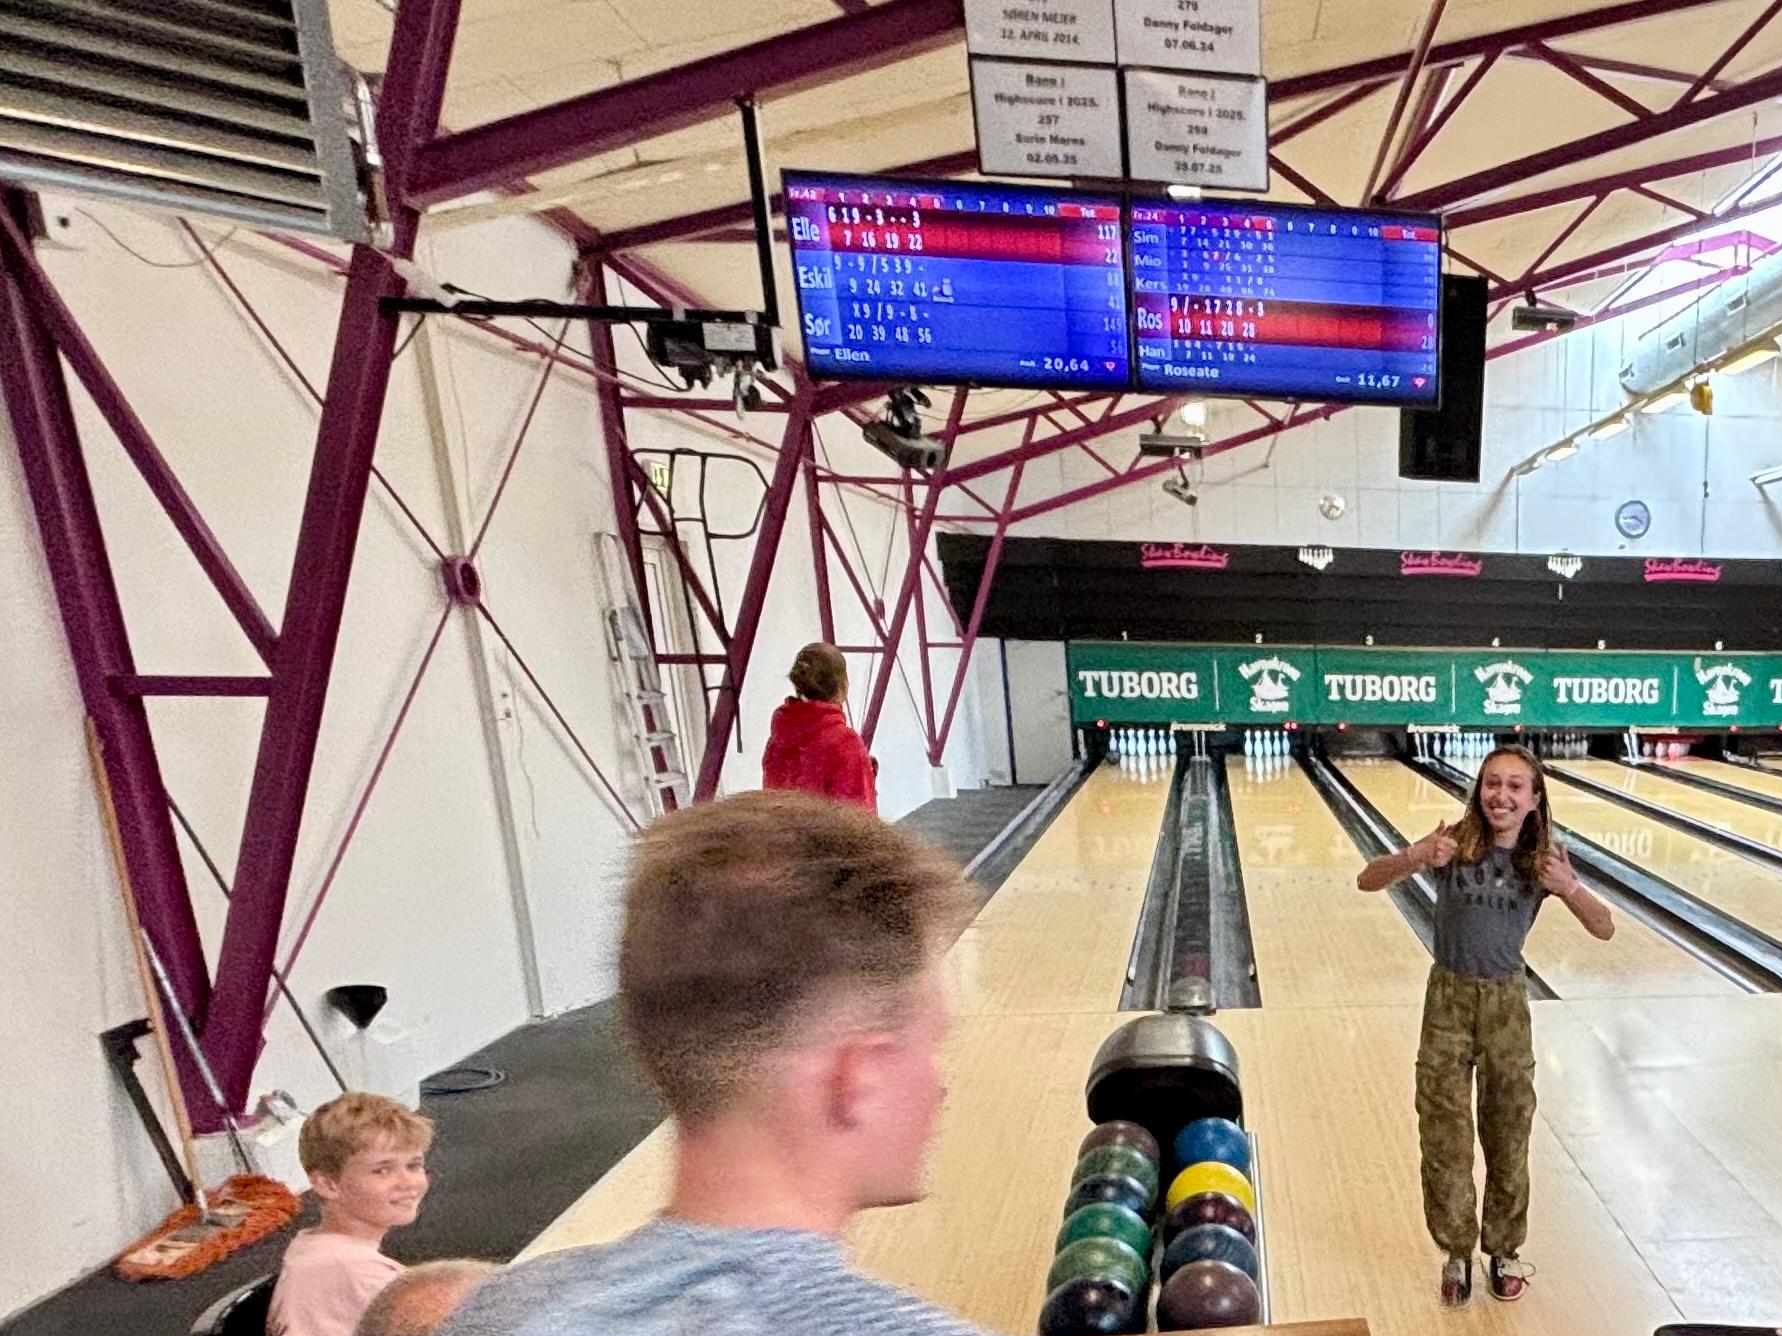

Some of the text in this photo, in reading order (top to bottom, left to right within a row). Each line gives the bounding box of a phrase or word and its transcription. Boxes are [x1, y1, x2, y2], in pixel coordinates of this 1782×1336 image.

[1144, 17, 1180, 32] Danny
[792, 215, 821, 242] Elle
[1098, 225, 1116, 240] 117
[1133, 230, 1160, 245] Sim
[1105, 248, 1119, 263] 22
[799, 265, 833, 289] Eskil
[804, 313, 831, 337] Sør
[1137, 306, 1163, 330] Ros
[848, 324, 932, 344] 20 39 48 56
[834, 347, 871, 362] Ellen
[1139, 344, 1166, 358] Han
[1164, 363, 1220, 379] Roseate
[1121, 630, 1128, 641] 1
[1255, 633, 1263, 644] 2
[1365, 634, 1374, 646] 3
[1491, 637, 1500, 648] 4
[1598, 639, 1606, 650] 5
[1078, 670, 1198, 699] TUBORG
[1324, 674, 1437, 702] TUBORG
[1552, 677, 1659, 704] TUBORG
